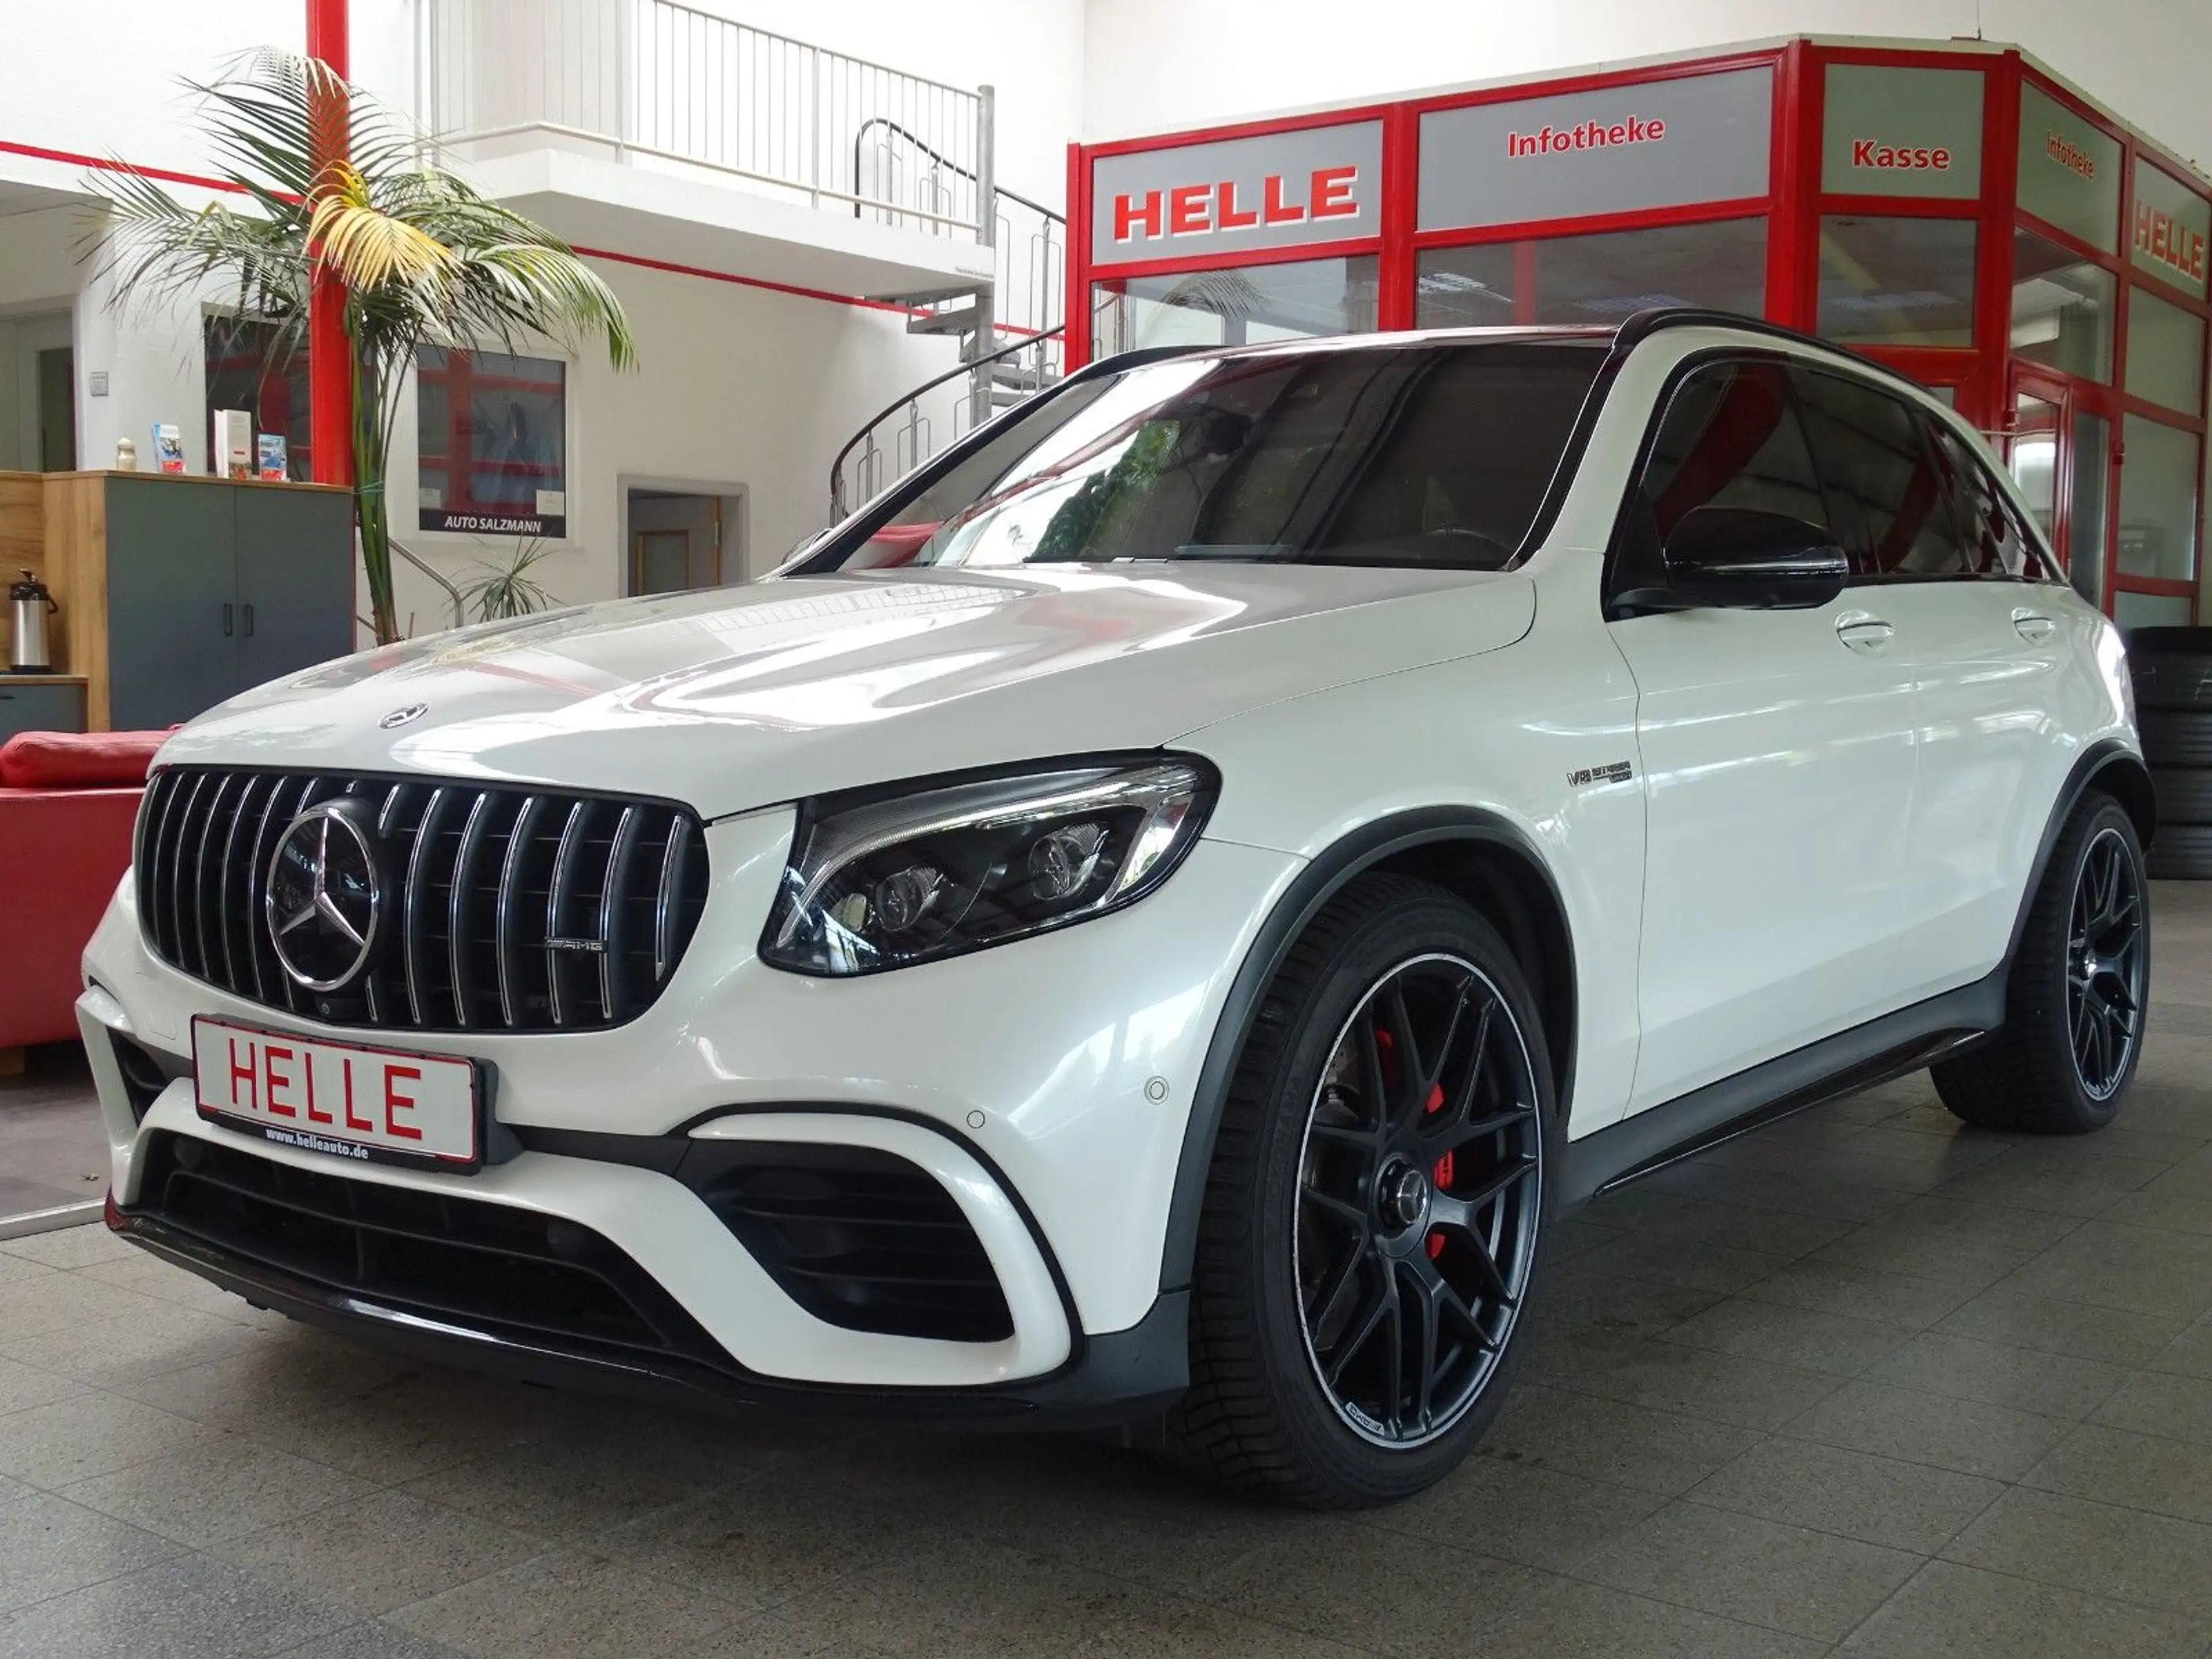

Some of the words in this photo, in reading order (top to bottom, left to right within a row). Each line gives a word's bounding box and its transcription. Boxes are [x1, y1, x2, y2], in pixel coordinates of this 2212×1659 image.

[1508, 116, 1665, 157] Infotheke
[1853, 140, 1950, 171] Kasse
[1114, 165, 1359, 242] HELLE
[2134, 200, 2204, 282] HELLE
[445, 516, 477, 529] AUTO
[479, 518, 542, 533] SALZMANN
[230, 1039, 422, 1140] HELLE
[266, 1128, 369, 1160] www.helleauto.de
